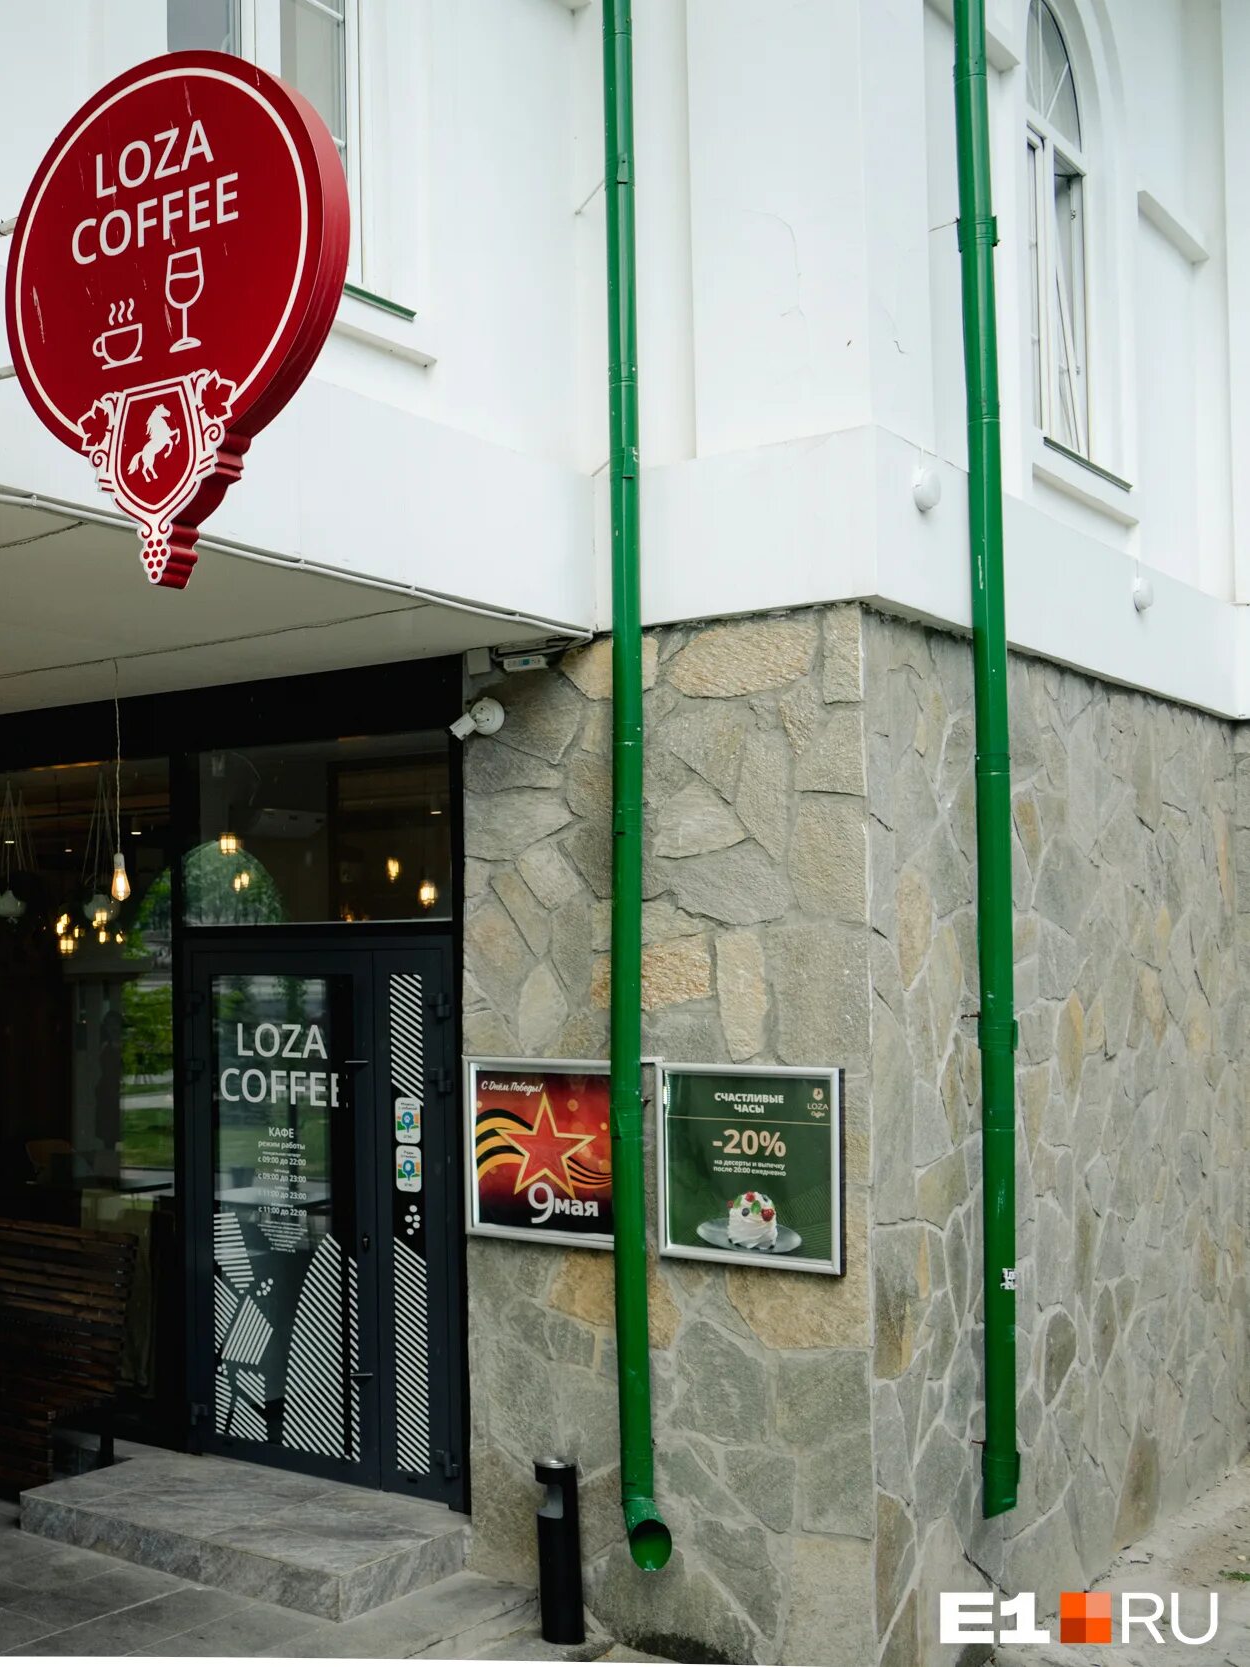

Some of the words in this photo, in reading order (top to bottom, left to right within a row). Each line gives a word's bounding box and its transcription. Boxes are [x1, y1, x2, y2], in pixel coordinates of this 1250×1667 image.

[95, 119, 215, 199] LOZA
[70, 172, 240, 266] COFFEE
[237, 1022, 328, 1060] LOZA
[510, 1081, 543, 1097] Победы!
[714, 1092, 784, 1104] СЧАСТЛИВЫЕ
[733, 1104, 765, 1114] ЧАСЫ
[807, 1102, 829, 1111] LOZA
[268, 1126, 295, 1139] КАФЕ
[258, 1140, 281, 1149] режим
[281, 1140, 306, 1151] работы
[712, 1129, 787, 1158] -20%
[262, 1155, 279, 1164] 09:00
[279, 1158, 289, 1166] до
[289, 1157, 307, 1166] 22:00
[757, 1161, 786, 1171] выпечку
[733, 1166, 751, 1174] 20:00
[751, 1168, 787, 1177] ежедневно
[279, 1174, 289, 1183] до
[289, 1174, 307, 1183] 23:00
[280, 1191, 289, 1200] до
[289, 1191, 307, 1200] 23:00
[527, 1181, 556, 1224] 9
[554, 1198, 599, 1219] мая
[263, 1206, 280, 1215] 11:00
[280, 1208, 289, 1217] до
[290, 1208, 307, 1217] 22:00
